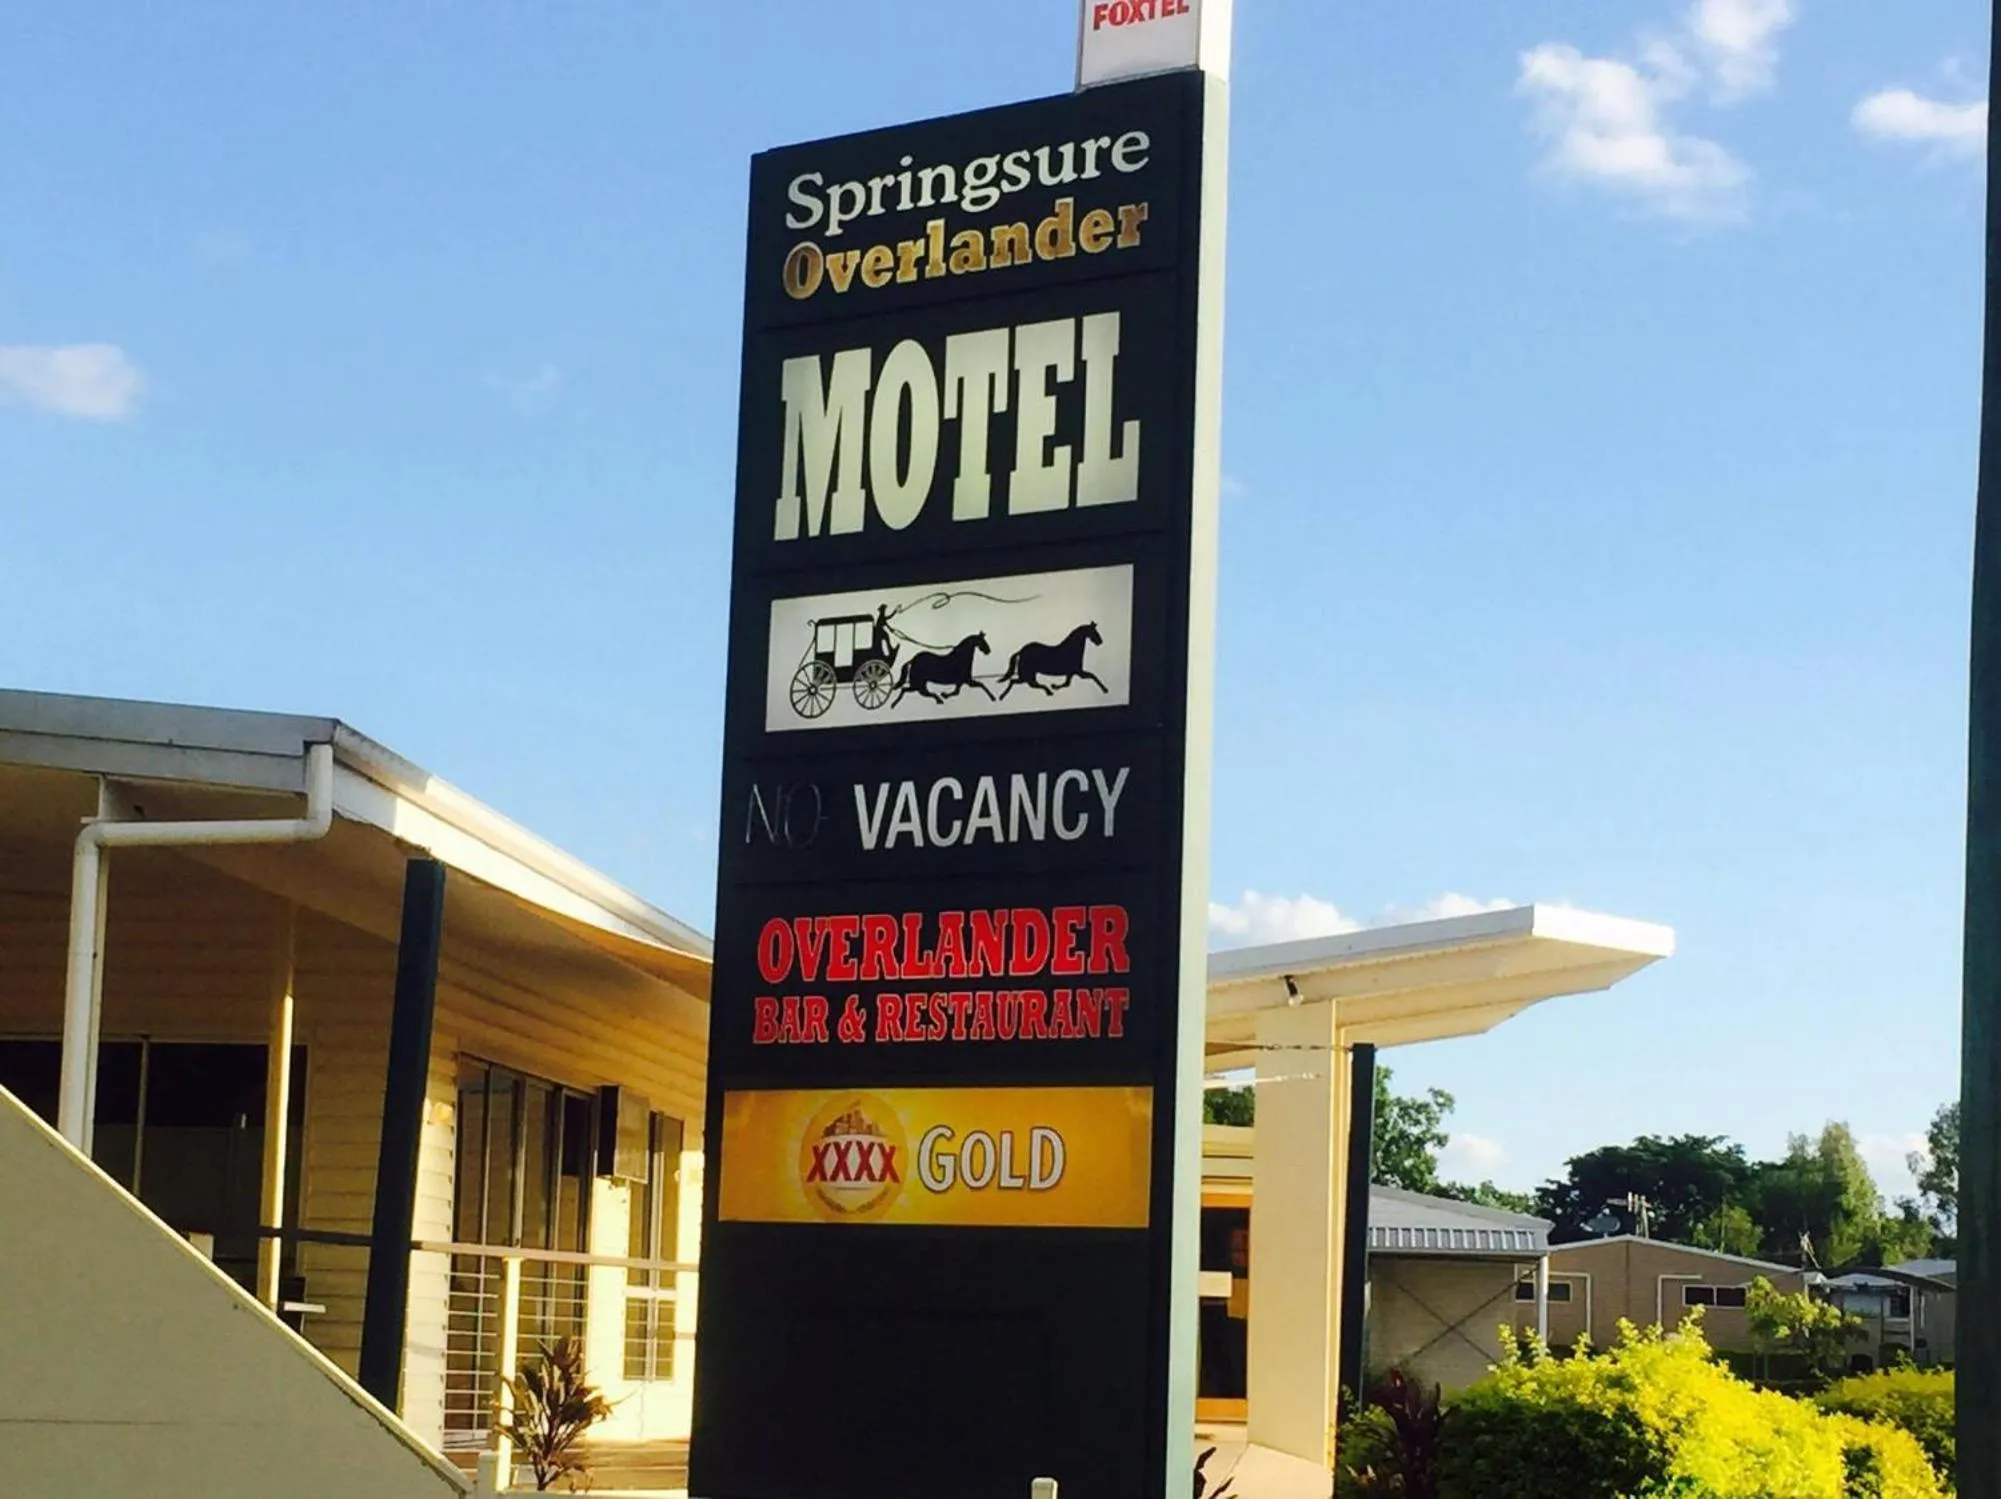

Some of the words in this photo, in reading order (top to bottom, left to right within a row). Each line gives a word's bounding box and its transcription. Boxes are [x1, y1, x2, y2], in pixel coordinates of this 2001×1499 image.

[1092, 0, 1190, 31] FOXTEL
[785, 129, 1150, 237] Springsure
[782, 197, 1149, 300] Overlander
[774, 311, 1140, 541] MOTEL
[853, 767, 1130, 850] VACANCY
[757, 905, 1131, 984] OVERLANDER
[753, 995, 829, 1044] BAR
[838, 993, 867, 1043] &
[875, 987, 1131, 1042] RESTAURANT
[806, 1139, 900, 1184] XXXX
[918, 1124, 1067, 1194] GOLD
